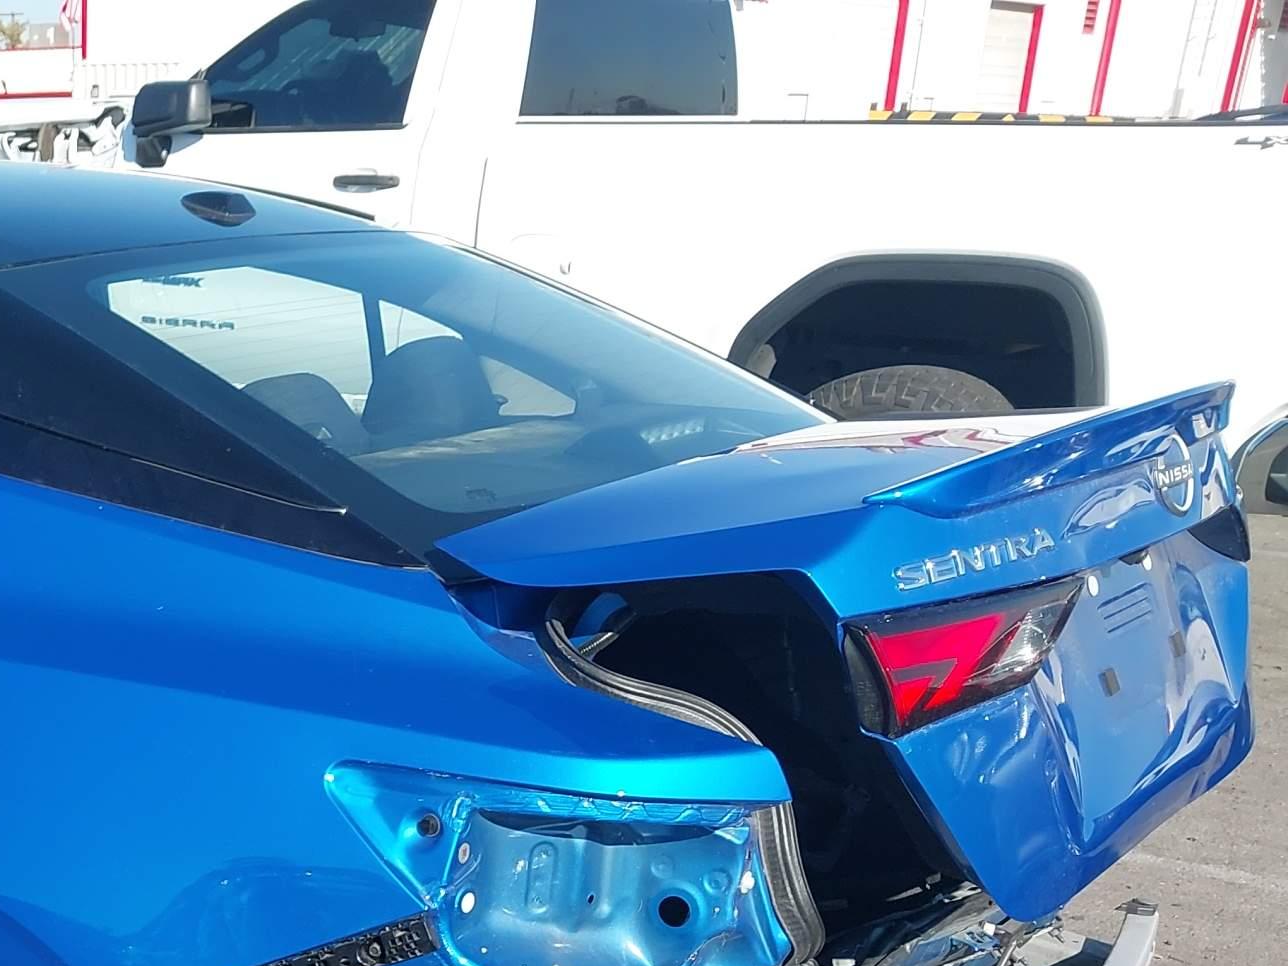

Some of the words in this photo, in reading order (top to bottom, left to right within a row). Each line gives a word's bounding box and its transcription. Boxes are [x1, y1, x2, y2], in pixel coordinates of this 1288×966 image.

[141, 315, 235, 330] SIERRA
[1157, 463, 1193, 486] NISS
[891, 527, 1057, 592] SENTRA
